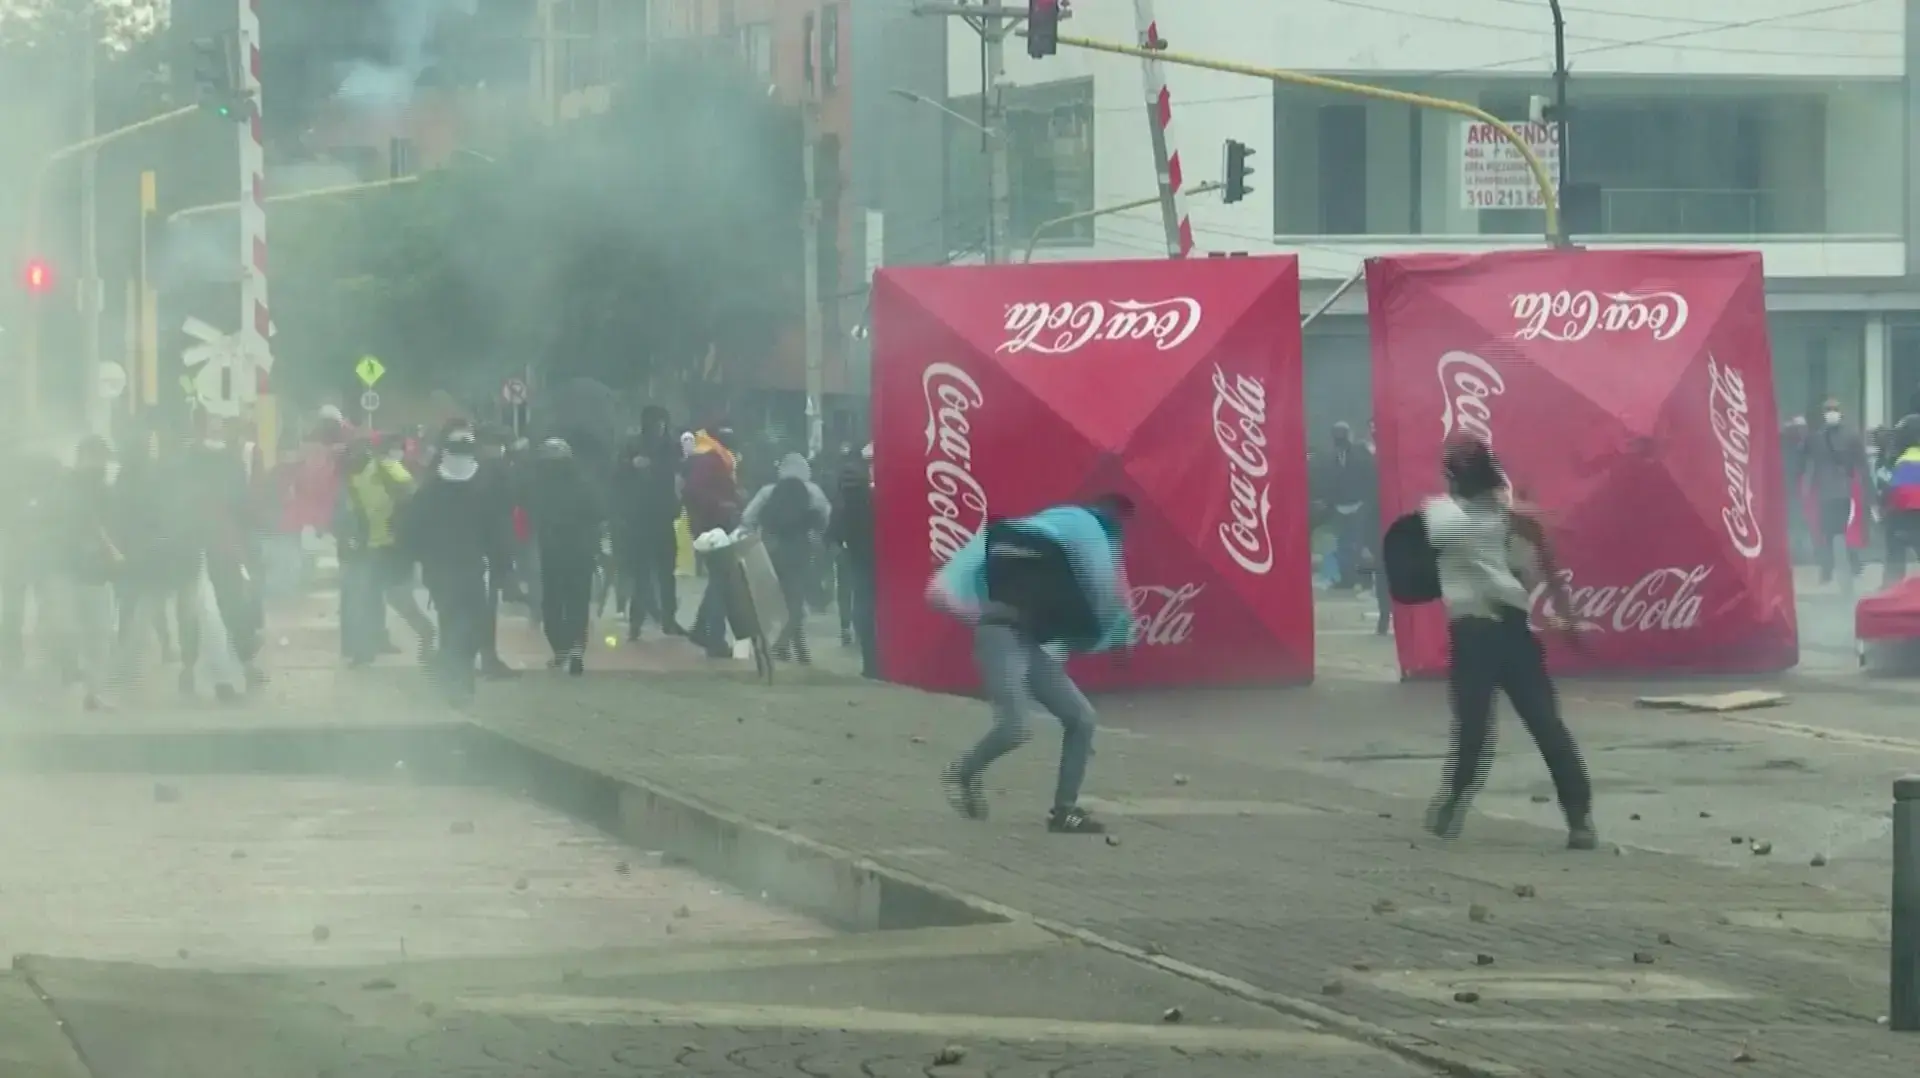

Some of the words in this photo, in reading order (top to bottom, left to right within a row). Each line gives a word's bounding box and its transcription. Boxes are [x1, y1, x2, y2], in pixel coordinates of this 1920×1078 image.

[1467, 124, 1558, 144] ARRENDO
[1467, 190, 1493, 206] 310
[1498, 190, 1523, 206] 213
[996, 297, 1201, 353] Coca-Cola
[1211, 362, 1274, 575] Coca-Cola
